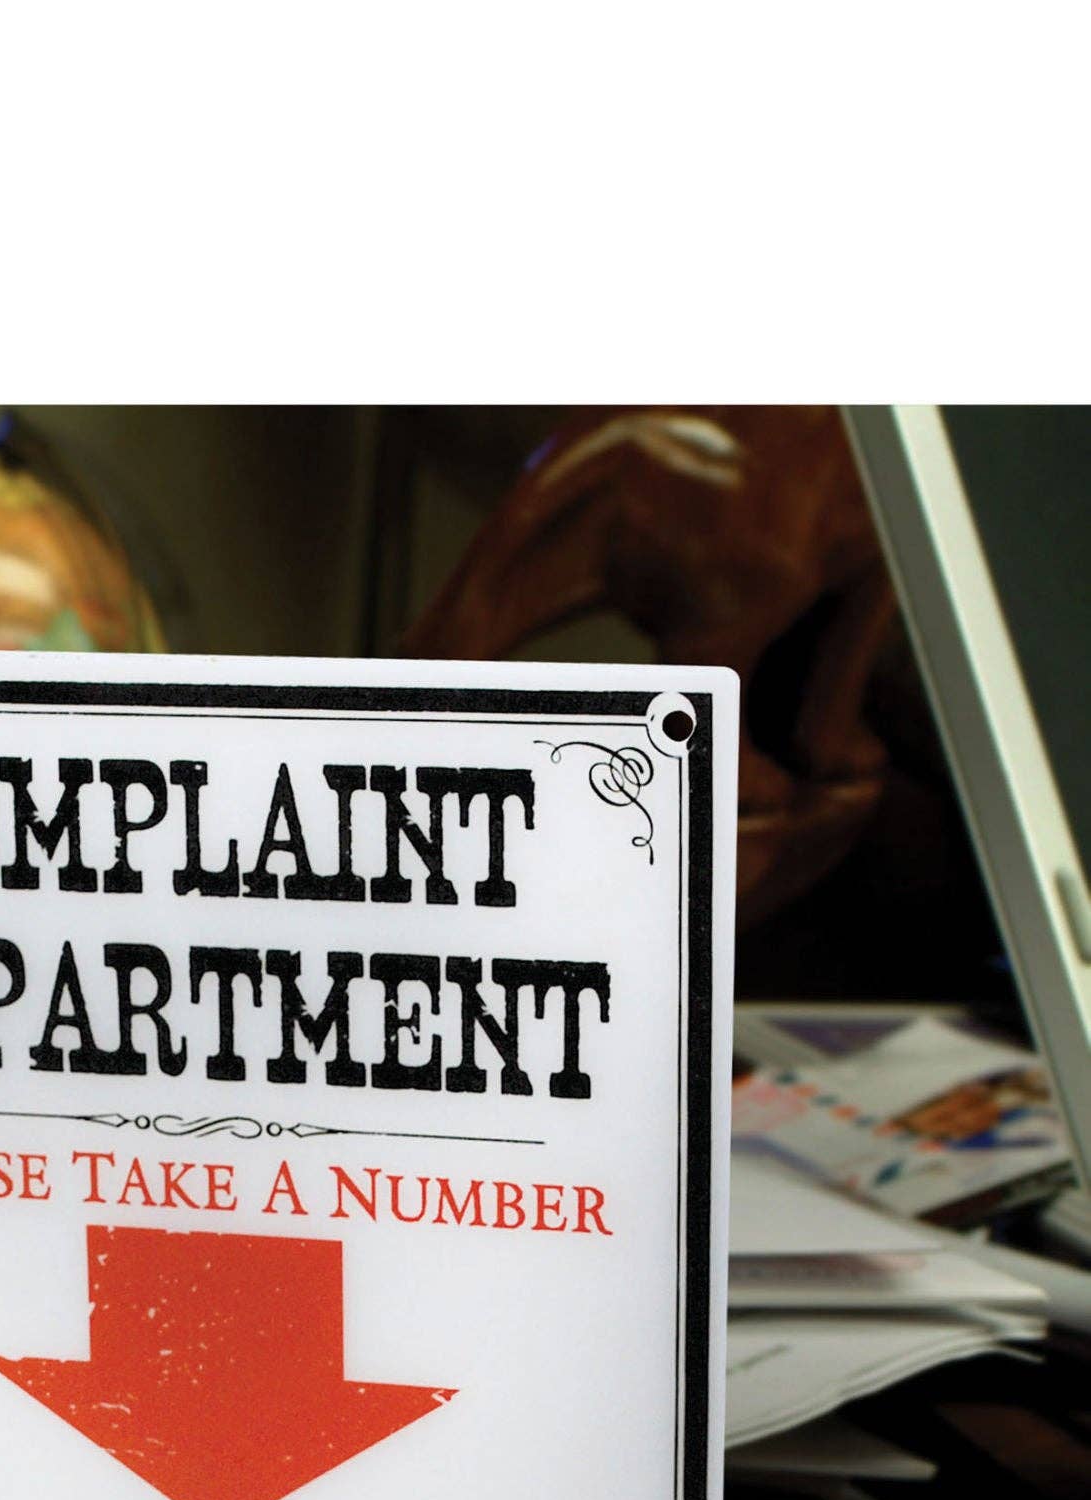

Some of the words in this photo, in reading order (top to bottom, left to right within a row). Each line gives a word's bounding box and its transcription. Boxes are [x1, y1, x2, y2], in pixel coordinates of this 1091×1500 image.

[73, 1151, 239, 1214] TAKE
[263, 1161, 309, 1218] A
[331, 1166, 615, 1237] NUMBER
